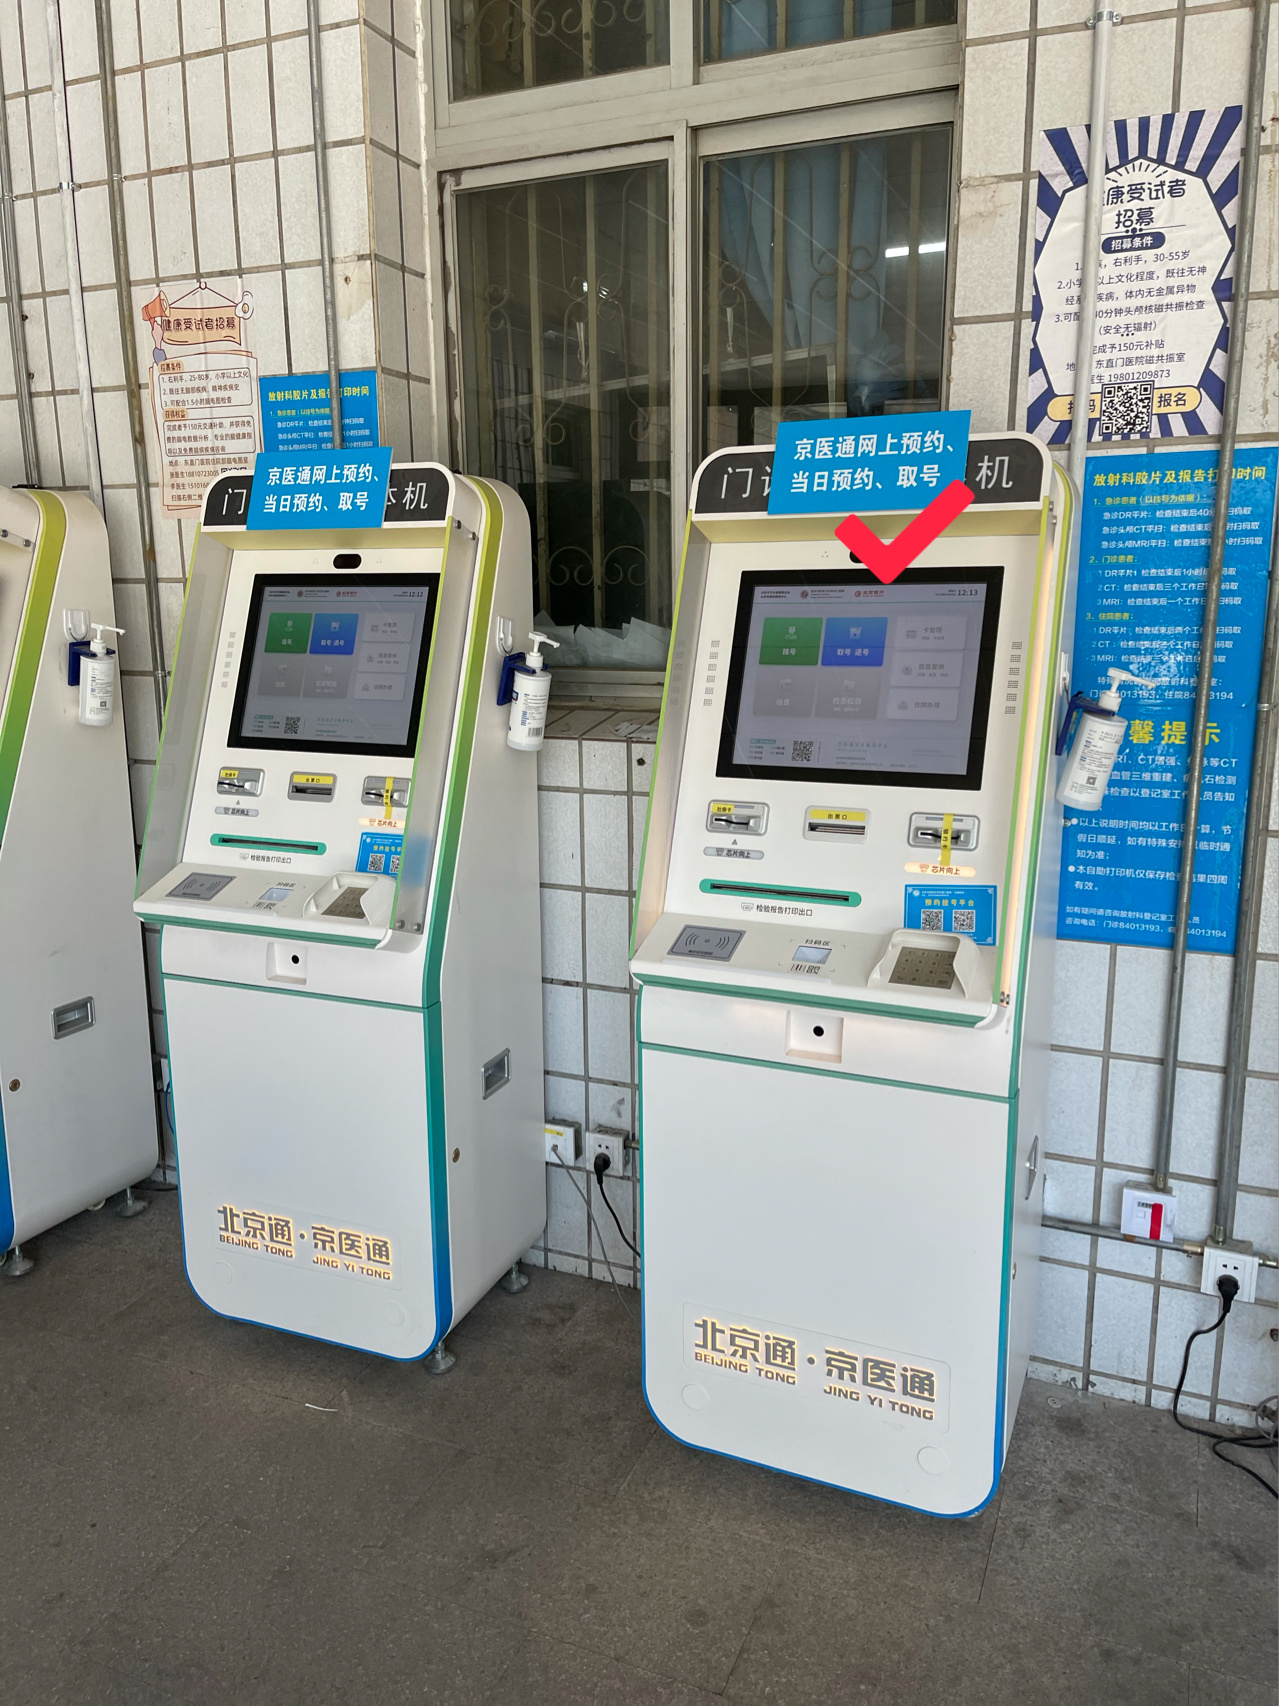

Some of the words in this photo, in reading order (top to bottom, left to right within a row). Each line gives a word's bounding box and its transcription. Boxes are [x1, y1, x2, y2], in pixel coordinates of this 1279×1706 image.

[1115, 207, 1155, 230] 招募
[1111, 236, 1154, 251] 招募条件
[1074, 250, 1190, 271] 1.，右利手，30-55岁
[1057, 265, 1207, 291] 2.小学以上文化程度，既往无神
[1065, 284, 1196, 306] 经系疾病，体内无金属异物
[1054, 300, 1205, 323] 3.可配0分钟头颅核磁共振检查
[163, 317, 236, 332] 健康受试者招募
[1066, 352, 1186, 372] 地东直门医院磁共振室
[1108, 369, 1171, 383] 19801209873
[268, 385, 369, 402] 放射科胶片及报印时间
[1157, 392, 1187, 408] 报名
[793, 430, 954, 461] 京医通网上预约、
[267, 464, 381, 486] 京医通网上预约、
[790, 464, 941, 494] 当日预约、取号
[976, 455, 1013, 490] 机
[1093, 466, 1266, 487] 放射科胶片及报告打时间
[171, 493, 204, 501] 扫描右侧二维
[263, 492, 369, 513] 当日预约、取号
[957, 589, 978, 597] 12:13
[782, 648, 797, 656] 挂号
[1111, 771, 1237, 786] 血管三维重建、石检测
[1104, 787, 1235, 802] 检查以登记室工员告知
[1079, 818, 1232, 835] 以上说明时间均以工作日算，节
[1077, 834, 1231, 852] 假日顺延，如有特殊安临时通
[726, 850, 751, 859] 芯片向上
[931, 865, 960, 875] 芯片向上
[756, 904, 813, 917] 检验报告打印出口
[1066, 906, 1200, 924] 如有疑问请咨询放射科登记室工员
[805, 938, 831, 946] 扫码区
[219, 1234, 259, 1250] BEIJING
[263, 1244, 293, 1258] TONG
[312, 1256, 339, 1269] JING
[344, 1262, 355, 1272] YI
[359, 1266, 391, 1280] TONG
[695, 1352, 749, 1374] BEIJING
[756, 1366, 796, 1386] TONG
[824, 1385, 860, 1402] JING
[867, 1394, 883, 1408] YI
[889, 1399, 934, 1421] TONG
